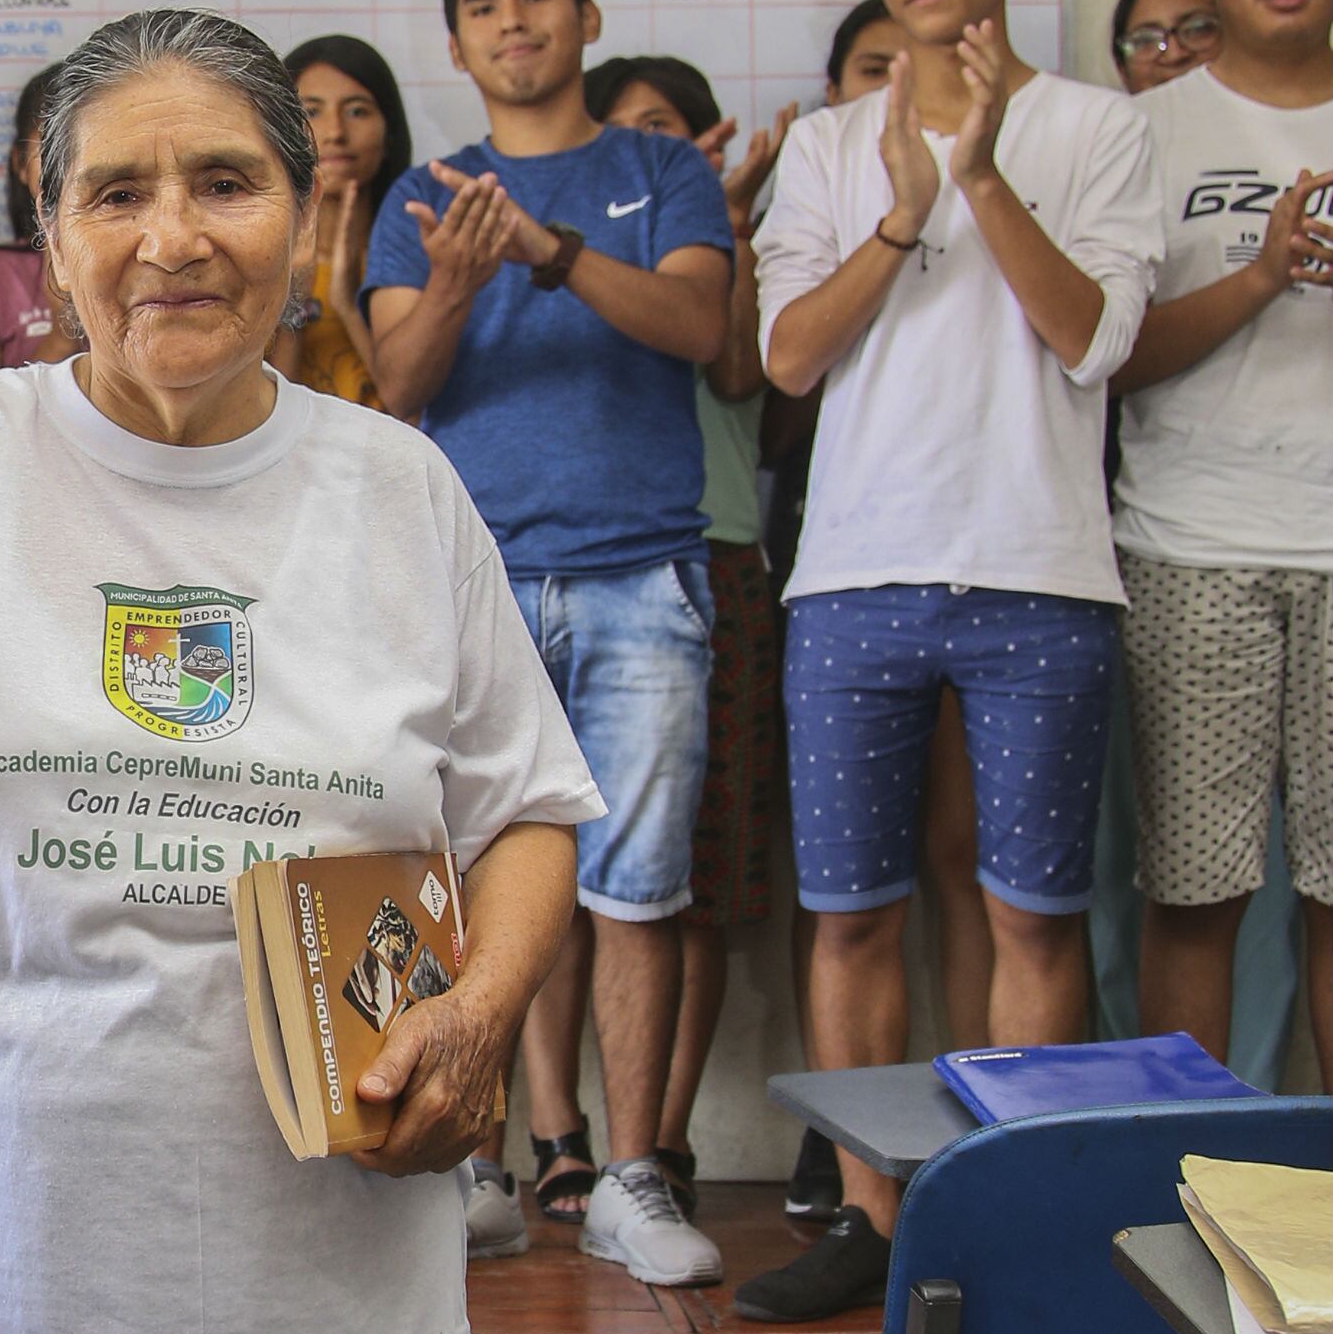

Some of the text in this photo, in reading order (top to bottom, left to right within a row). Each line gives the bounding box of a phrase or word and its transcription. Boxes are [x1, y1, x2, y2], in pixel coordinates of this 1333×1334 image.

[110, 592, 177, 603] MUNICIPALIDAD
[178, 592, 189, 602] DE
[190, 591, 220, 601] SANTA
[127, 610, 231, 624] EMPRENDEDOR
[110, 621, 122, 692] DISTRITO
[235, 621, 248, 706] CULTURAL
[126, 705, 236, 737] PROGRESISTA
[106, 750, 242, 784] CepreMuni
[250, 762, 320, 791] Santa
[326, 770, 385, 800] Anita
[67, 788, 302, 829] Con la Educación
[17, 828, 119, 870] José
[134, 833, 226, 873] Luis
[122, 884, 227, 907] ALCALDE
[297, 882, 321, 978] TEÓRICO
[314, 890, 332, 958] Letras
